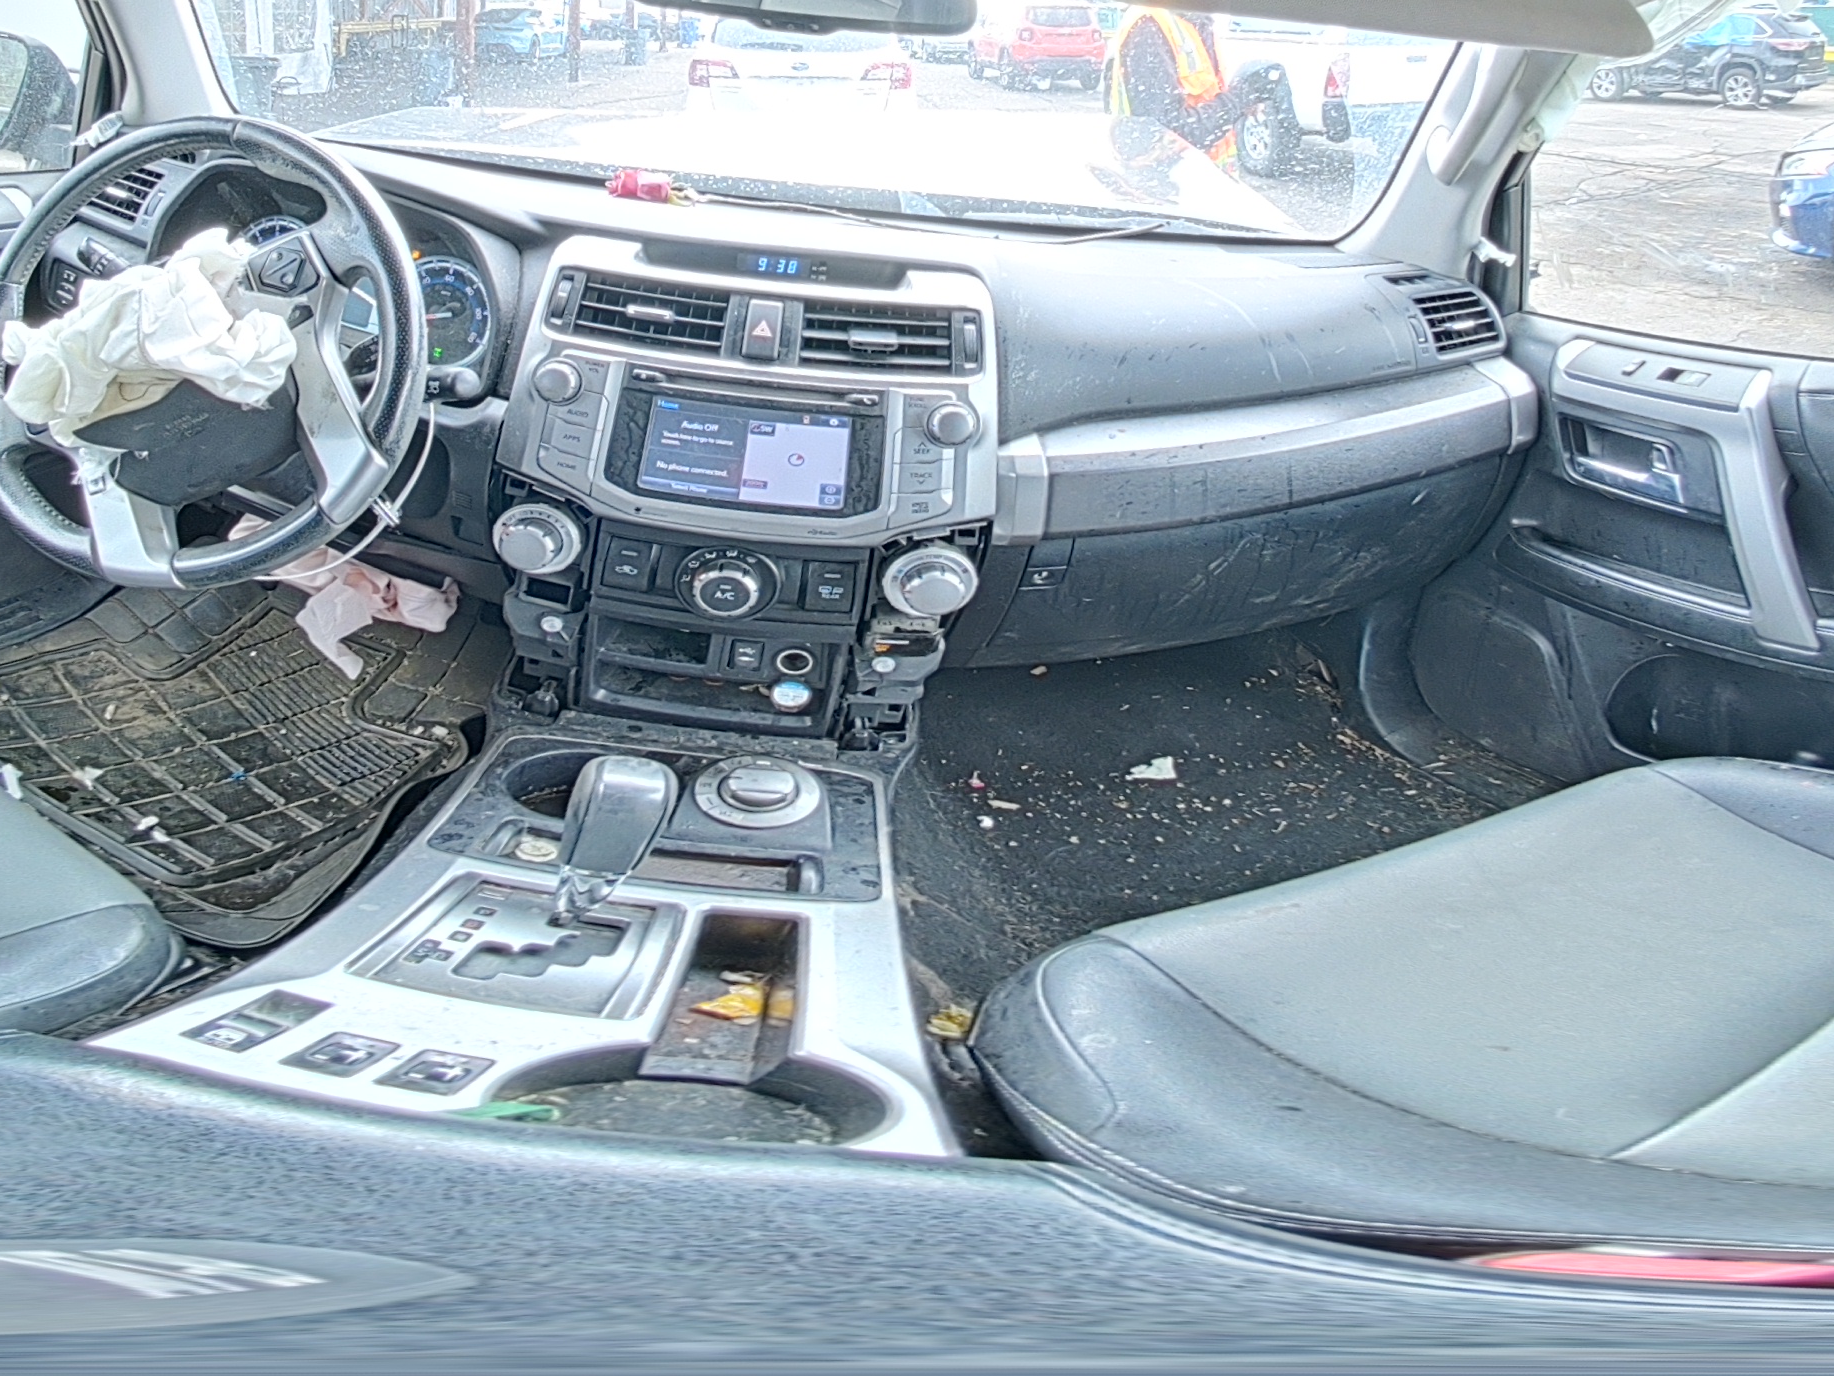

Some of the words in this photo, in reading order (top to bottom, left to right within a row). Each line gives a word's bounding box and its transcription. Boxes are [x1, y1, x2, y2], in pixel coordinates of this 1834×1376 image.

[566, 408, 589, 418] AUDIO
[681, 420, 704, 432] Audio
[704, 423, 719, 432] Off
[562, 434, 581, 443] APPS
[556, 461, 577, 470] HOME
[656, 460, 668, 469] No
[668, 463, 690, 472] phone
[690, 467, 728, 477] connected.
[714, 591, 735, 601] A/C
